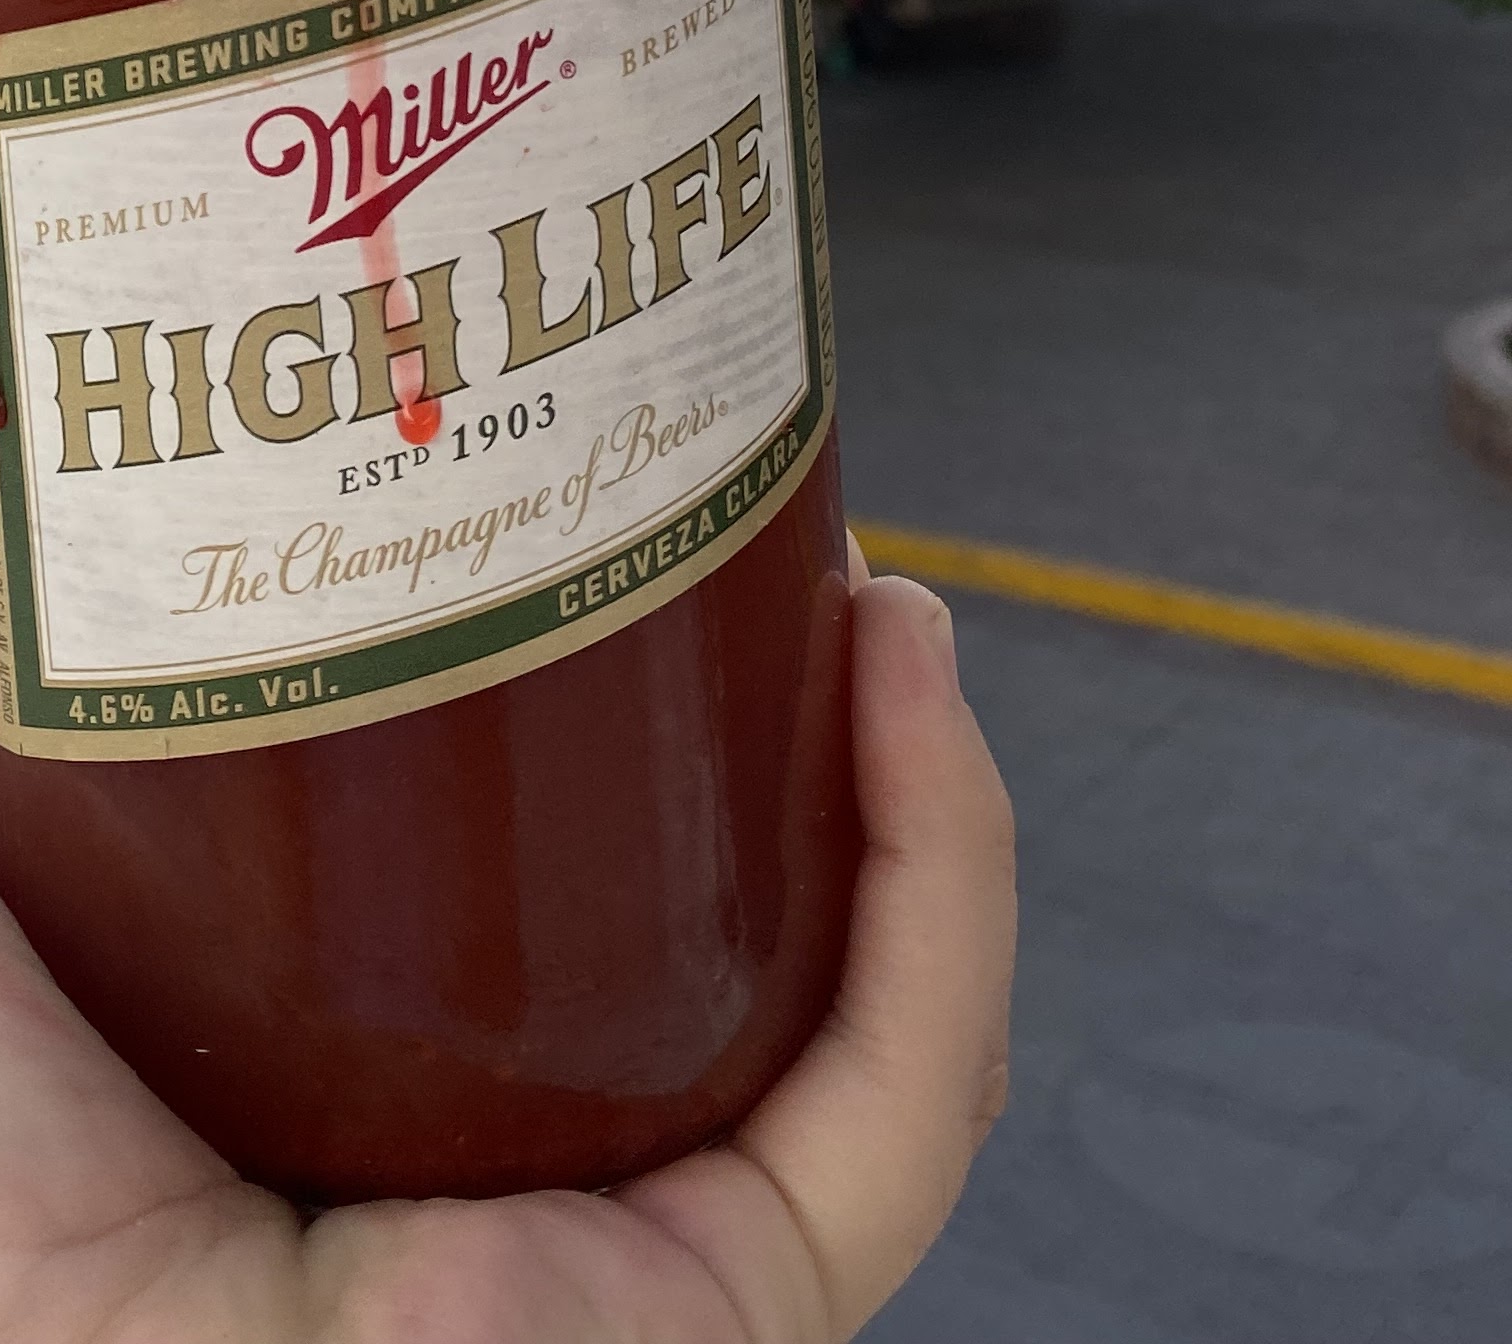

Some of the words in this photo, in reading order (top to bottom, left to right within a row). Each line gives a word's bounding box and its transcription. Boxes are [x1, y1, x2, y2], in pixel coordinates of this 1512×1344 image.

[123, 18, 309, 92] BREWING
[803, 50, 817, 130] 940
[245, 27, 554, 232] Miller
[33, 190, 211, 247] PREMIUM
[45, 255, 471, 474] HIGH
[487, 94, 774, 376] LIFE
[450, 390, 558, 464] 1903
[170, 537, 270, 617] The
[275, 485, 554, 594] Champagne
[559, 428, 606, 537] of
[557, 513, 717, 621] CERVEZA
[724, 425, 800, 521] CLARA
[0, 661, 16, 726] ALFONSO
[68, 693, 155, 725] 4.6%
[170, 686, 244, 722] Alc.
[258, 666, 339, 709] Vol.
